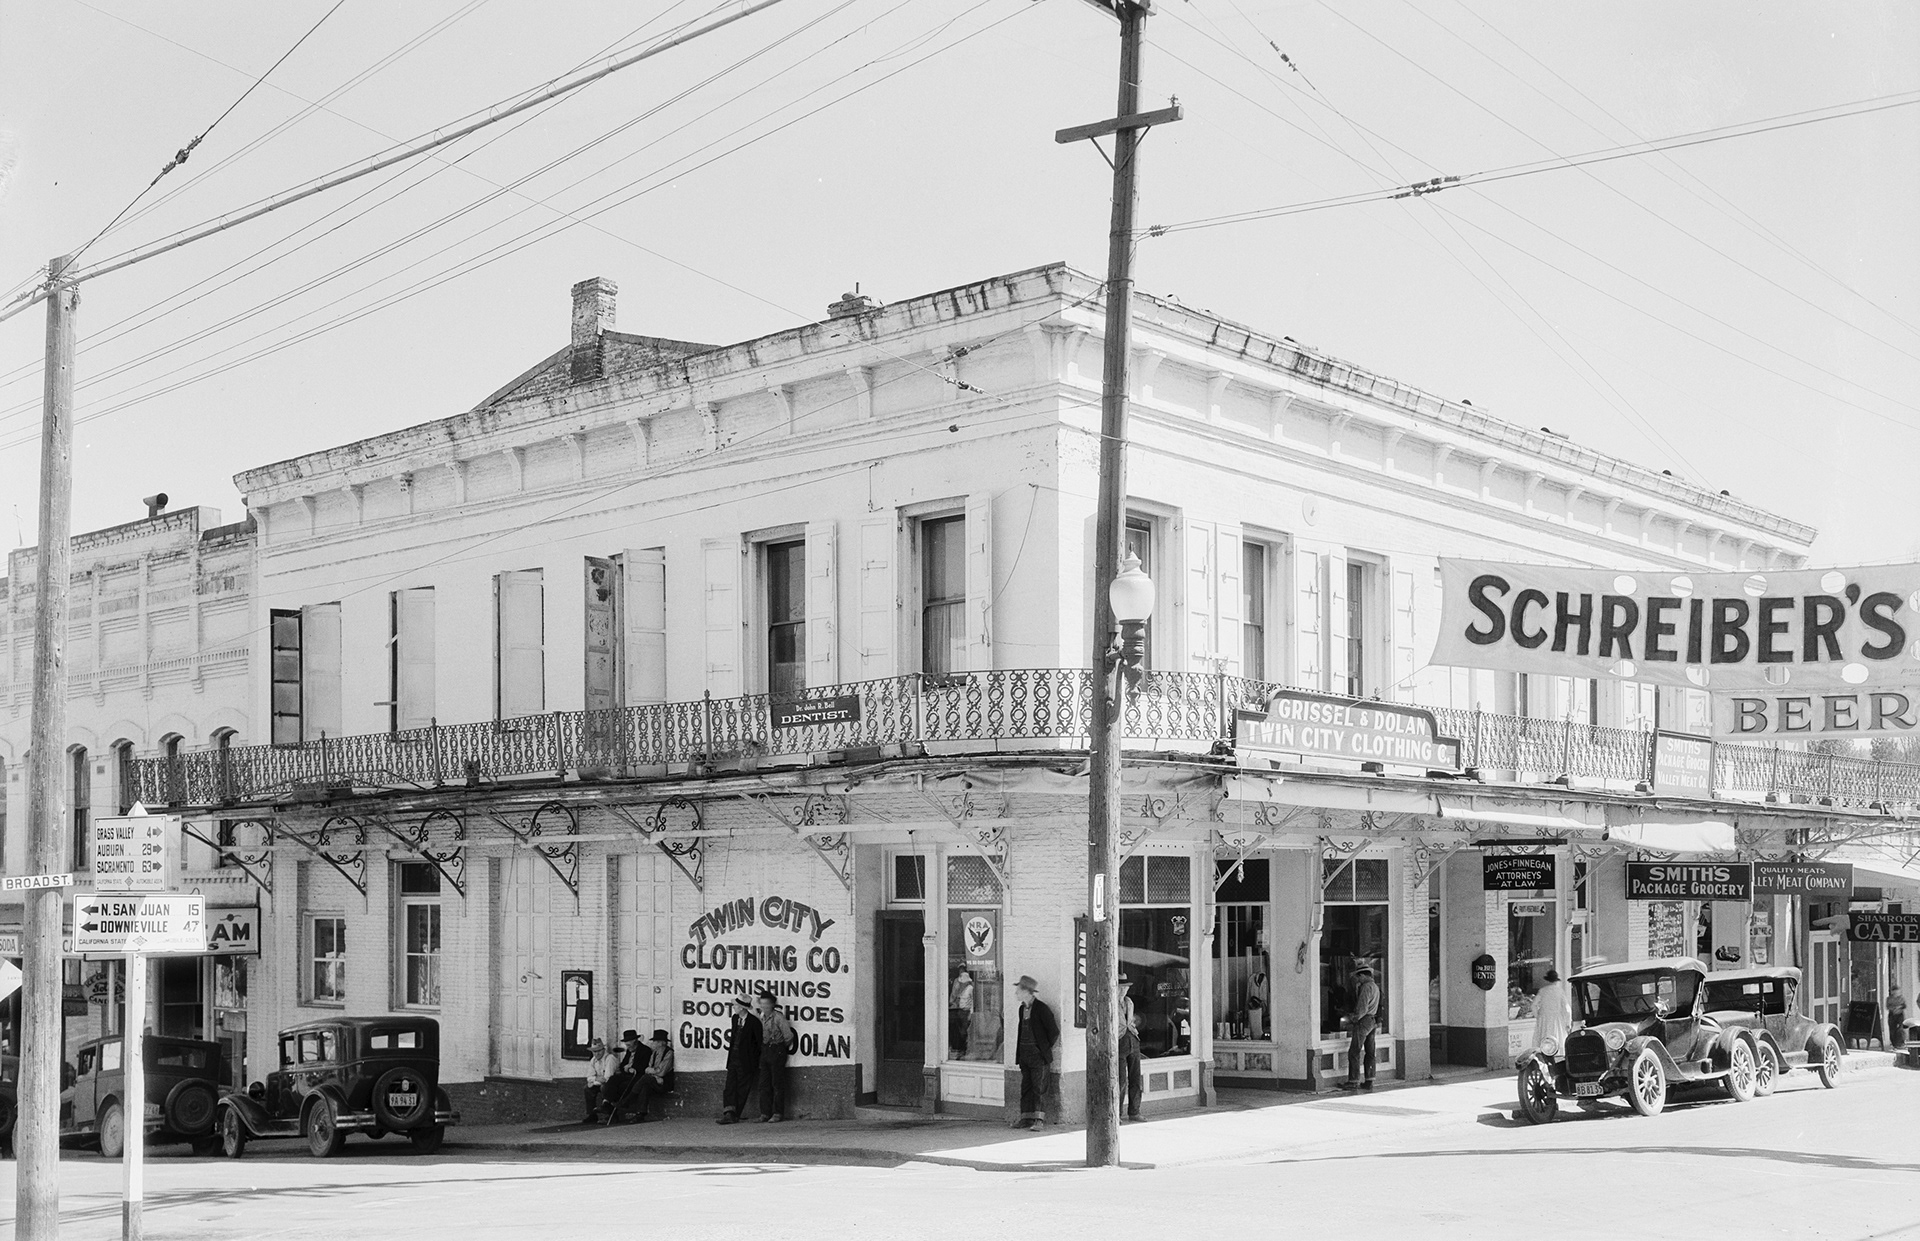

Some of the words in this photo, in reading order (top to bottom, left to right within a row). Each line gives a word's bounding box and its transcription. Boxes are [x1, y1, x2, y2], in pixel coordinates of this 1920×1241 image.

[1464, 574, 1907, 662] SCHREIBER'S
[781, 710, 852, 724] DENTIST.
[1279, 699, 1354, 727] GRISSEL
[1359, 711, 1368, 726] &
[1374, 711, 1426, 736] DOLAN
[1730, 692, 1918, 734] BEER
[1246, 720, 1295, 746] TWIN
[1301, 727, 1345, 752] CITY
[1351, 732, 1432, 761] CLOTHING
[97, 828, 114, 840] GRASS
[116, 827, 134, 840] VALLEY
[146, 826, 152, 838] 4
[97, 844, 124, 856] AUBURN
[142, 844, 152, 856] 29
[97, 861, 134, 874] SACRAMENTO
[142, 860, 152, 872] 63
[1485, 860, 1508, 873] JONES
[1512, 858, 1552, 872] FINNEGAN
[1649, 866, 1730, 882] SMITH'S
[6, 876, 50, 889] BROAD
[52, 875, 70, 886] ST.
[1496, 872, 1542, 880] ATTORNEYS
[1753, 876, 1774, 887] LLEY
[1776, 874, 1802, 890] MEAT
[1805, 875, 1847, 890] COMPANY
[1632, 879, 1686, 894] PACKAGE
[1690, 882, 1744, 896] GROCERY
[101, 904, 112, 916] N.
[113, 904, 136, 916] SAN
[140, 904, 170, 916] JUAN
[188, 904, 200, 916] 15
[100, 920, 168, 933] DOWNIEVILLE
[182, 920, 200, 932] 47
[688, 896, 755, 944] TWIN
[760, 896, 836, 942] CITY
[206, 922, 250, 942] AM
[1854, 922, 1919, 941] CAFE
[680, 944, 798, 972] CLOTHING
[806, 946, 850, 974] CO.
[693, 978, 831, 998] FURNISHINGS
[682, 1000, 735, 1018] BOOT
[680, 1021, 733, 1051] GRISS
